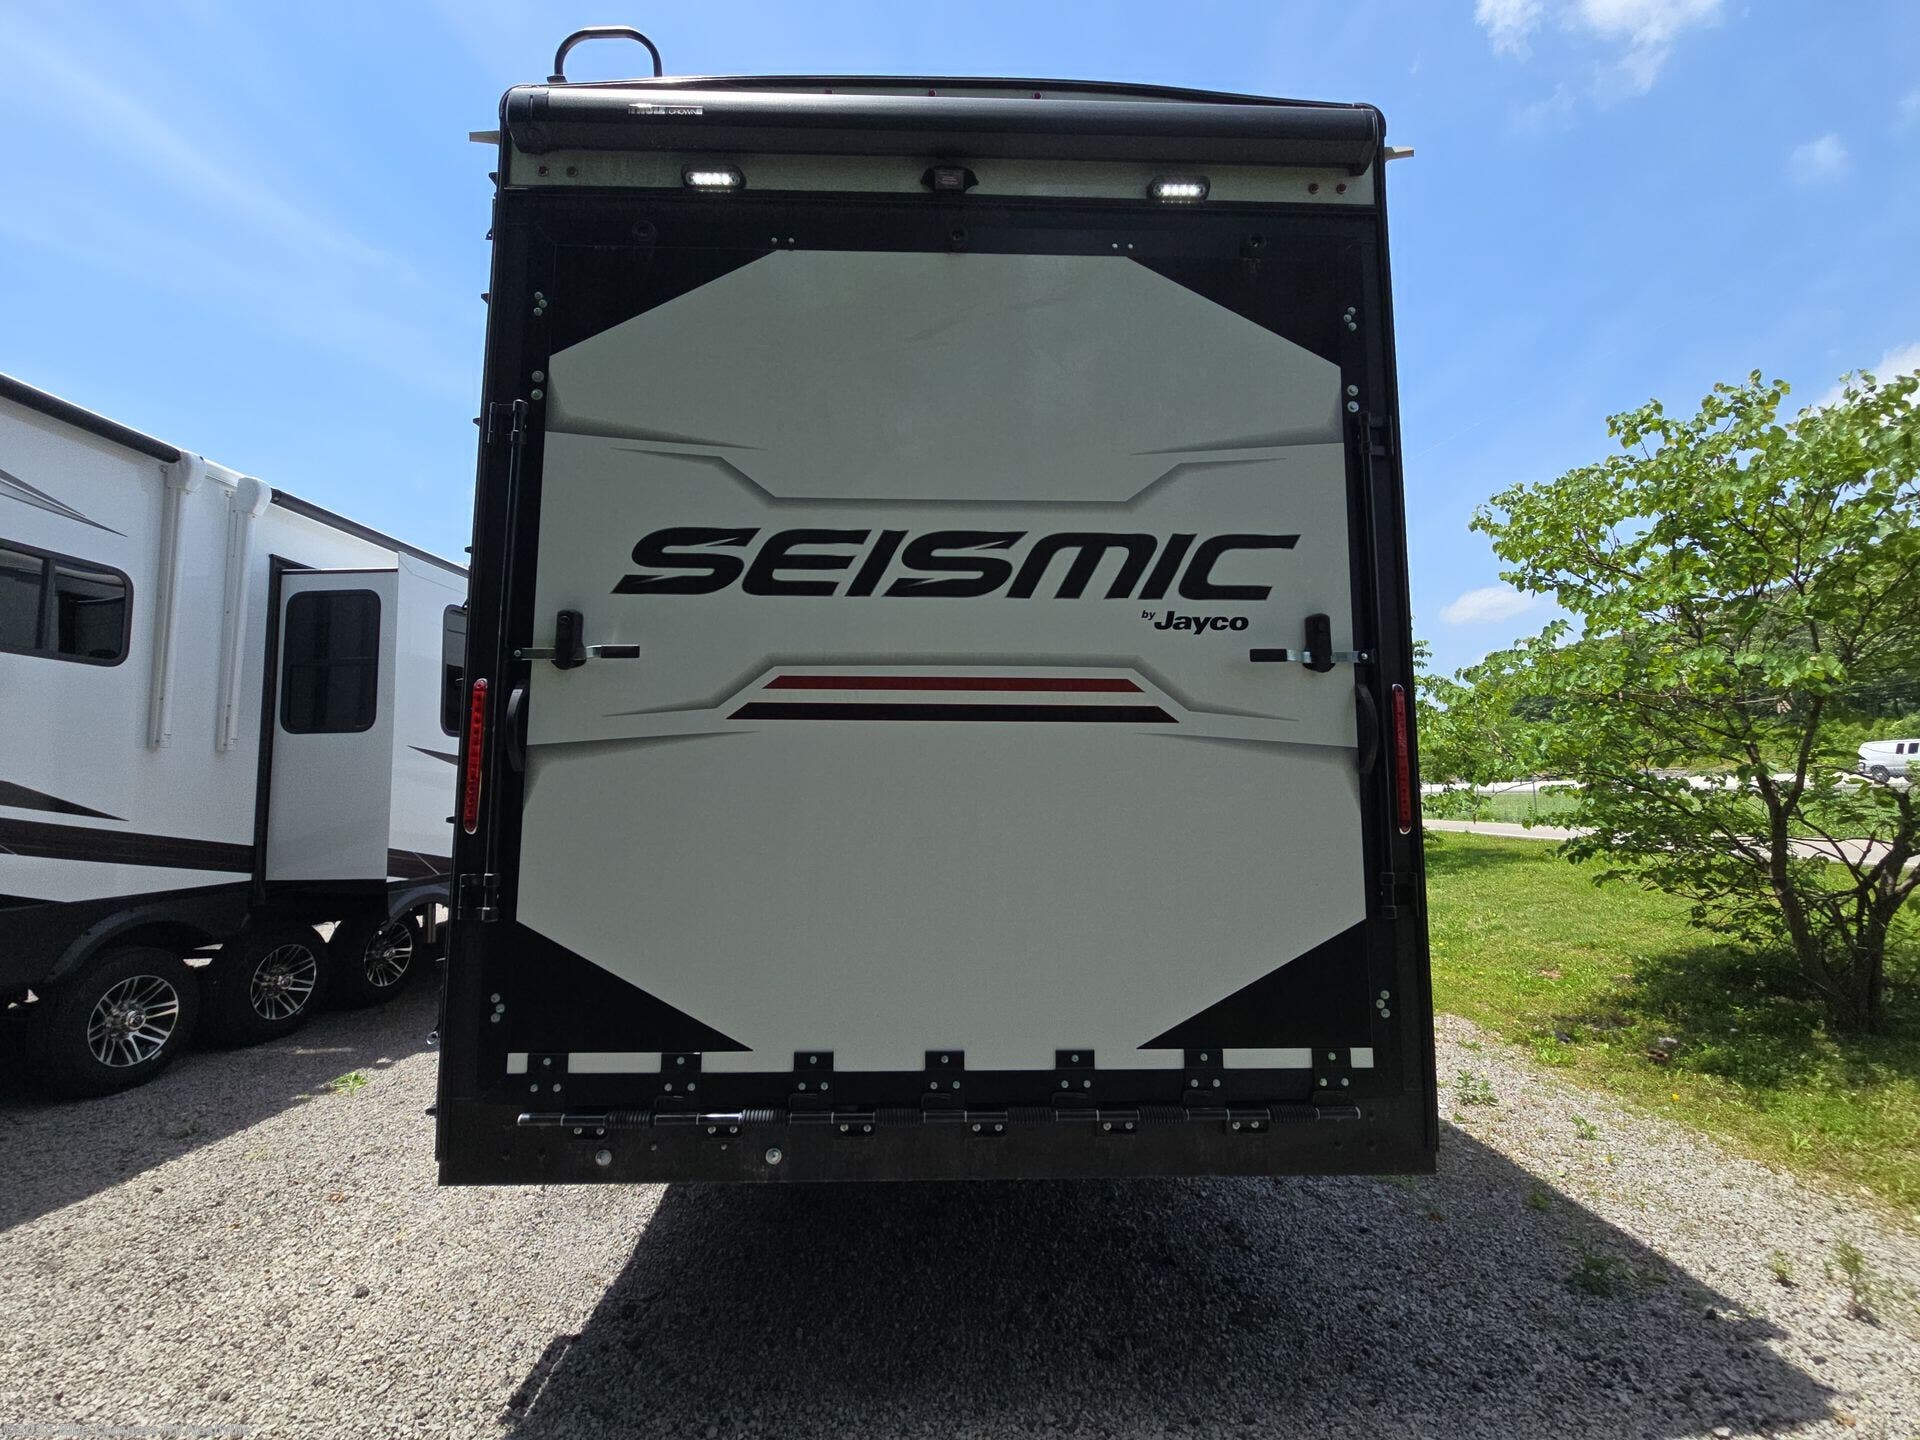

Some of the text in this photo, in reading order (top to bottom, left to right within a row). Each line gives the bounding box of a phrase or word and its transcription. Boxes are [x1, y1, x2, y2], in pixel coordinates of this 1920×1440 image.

[611, 526, 1301, 601] SEISMIC
[1141, 609, 1250, 635] by Jayco
